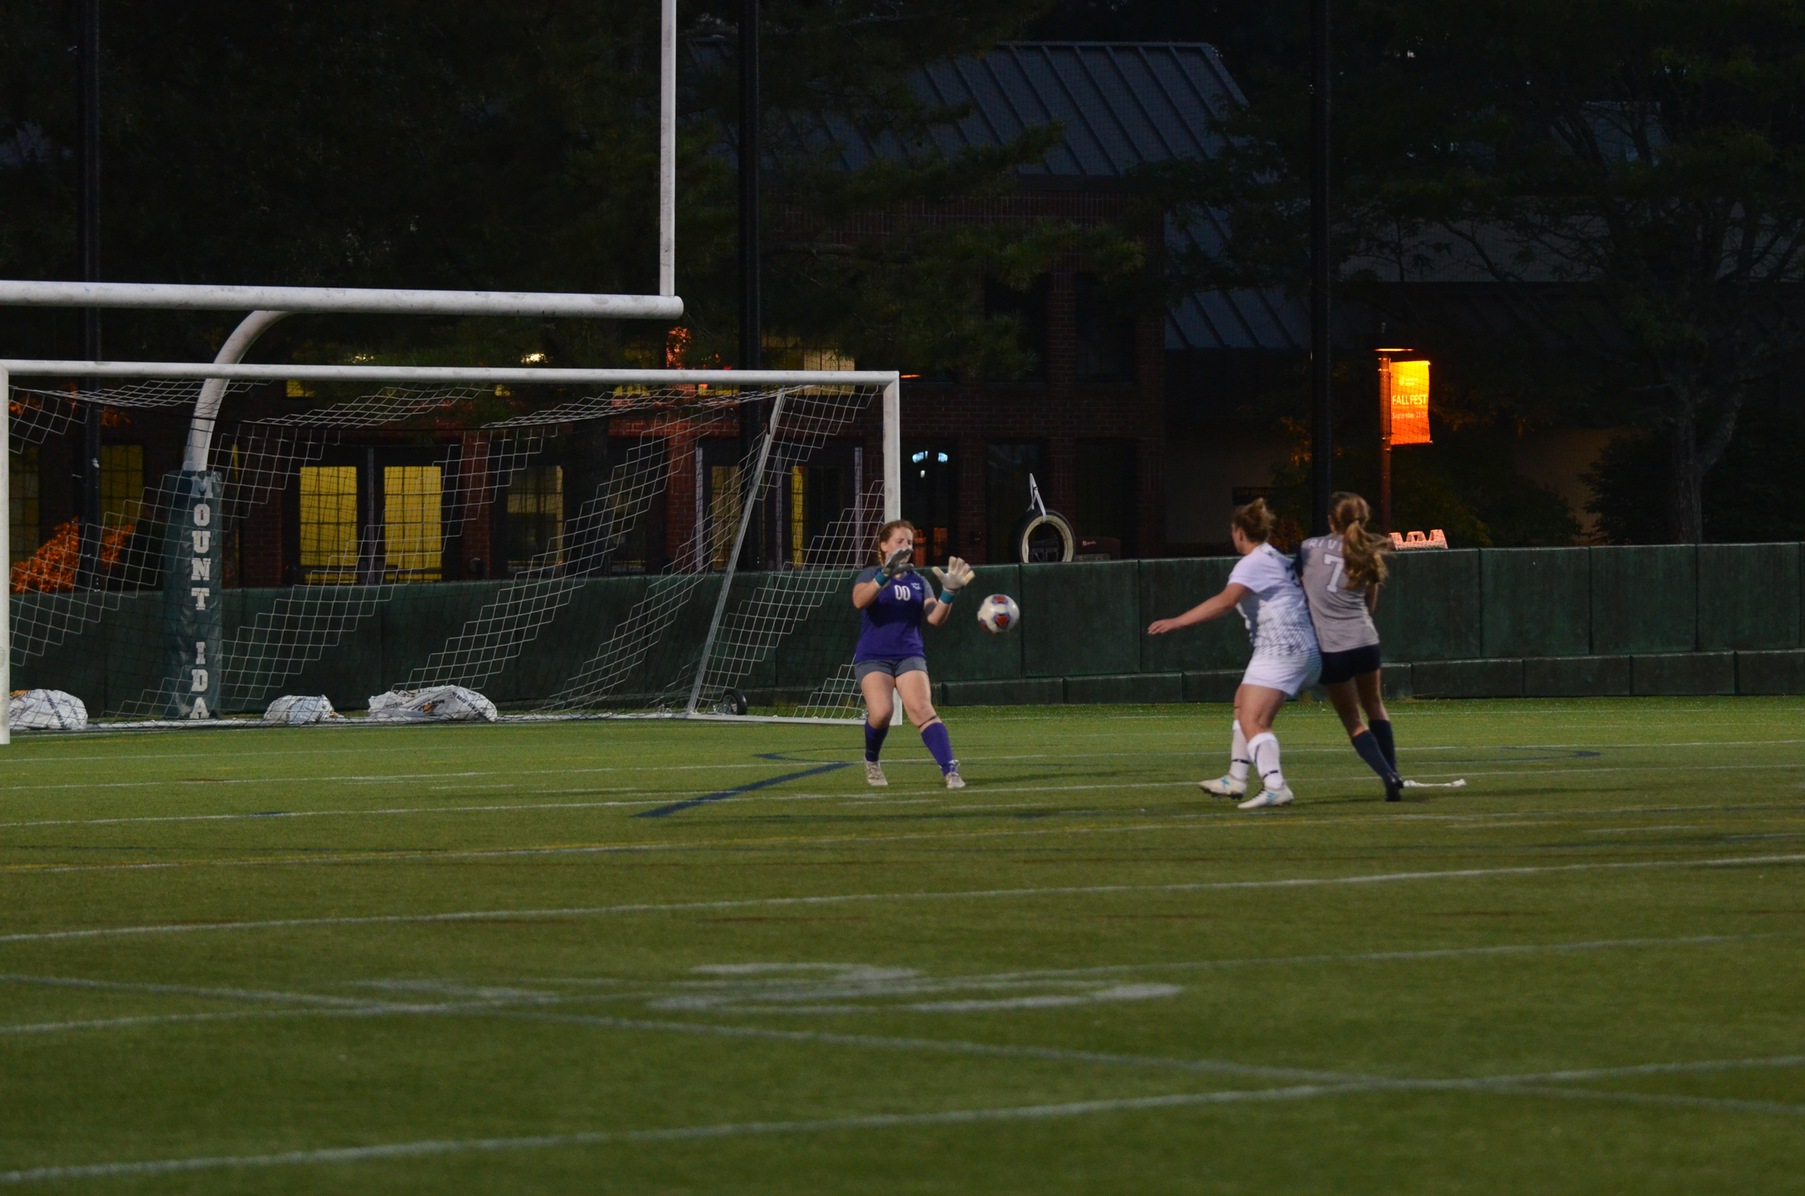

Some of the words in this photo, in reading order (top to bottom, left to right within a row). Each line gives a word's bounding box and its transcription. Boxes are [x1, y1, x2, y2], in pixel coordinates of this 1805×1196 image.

[1392, 394, 1409, 405] FALL
[1410, 394, 1428, 405] FEST
[191, 476, 212, 610] MOUNT
[894, 584, 911, 601] 00
[1324, 554, 1344, 593] 7
[189, 641, 209, 719] IDA
